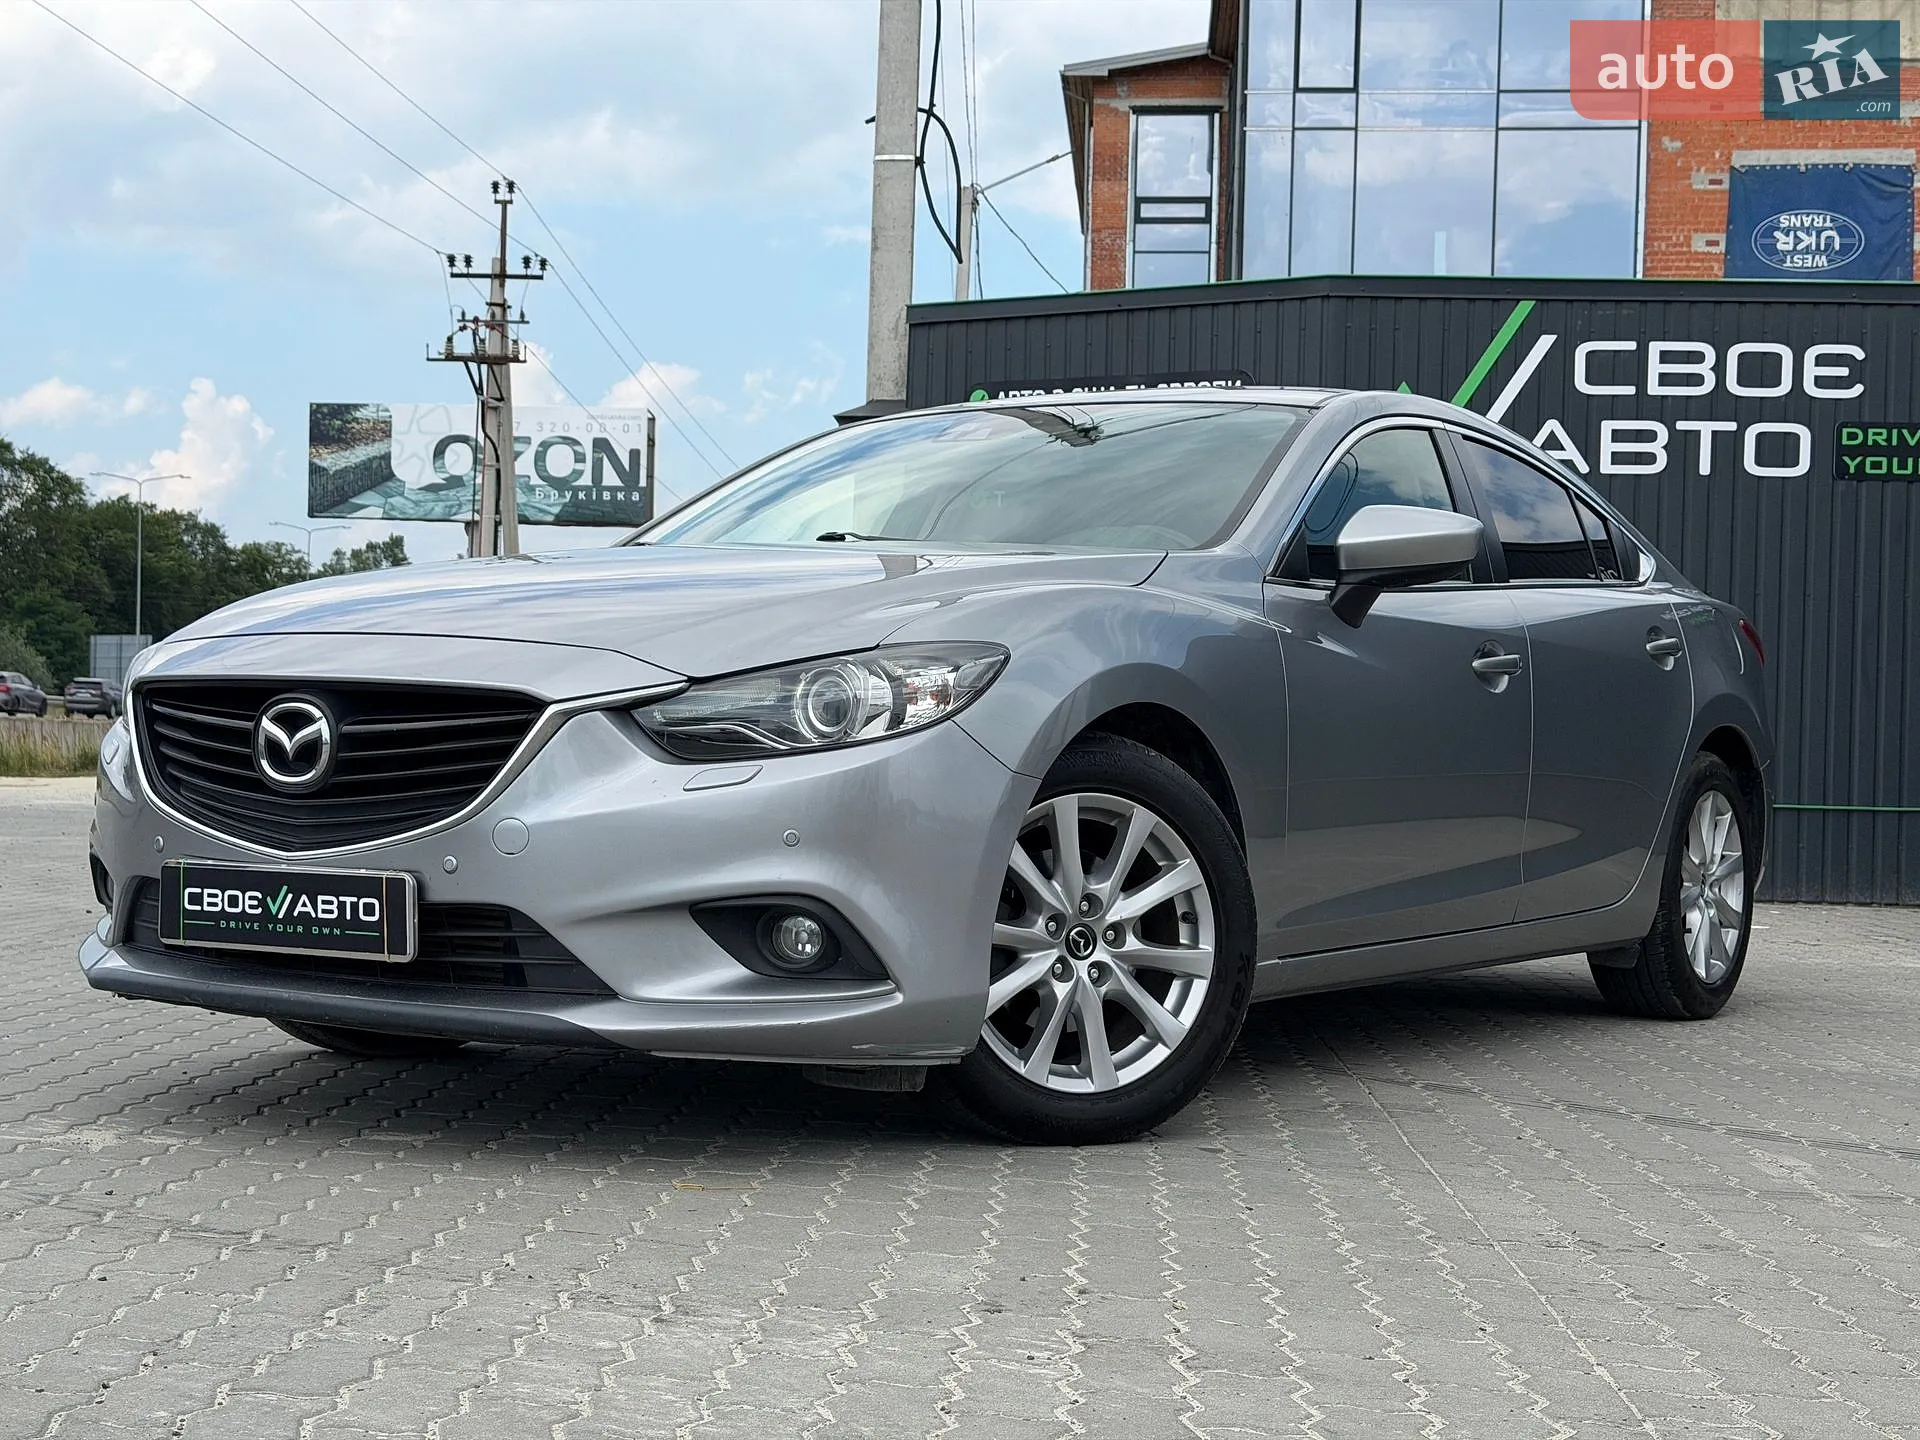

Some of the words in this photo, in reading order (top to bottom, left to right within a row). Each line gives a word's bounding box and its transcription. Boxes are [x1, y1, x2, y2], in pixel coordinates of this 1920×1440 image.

[1779, 214, 1833, 228] TRANS
[1773, 230, 1841, 251] UKR
[1782, 254, 1829, 268] WEST
[1841, 455, 1920, 475] YOU
[535, 487, 641, 503] Бруківка
[293, 894, 380, 922] АВТО
[219, 920, 260, 931] DRIVE
[268, 923, 304, 934] YOUR
[312, 926, 342, 936] OWN
